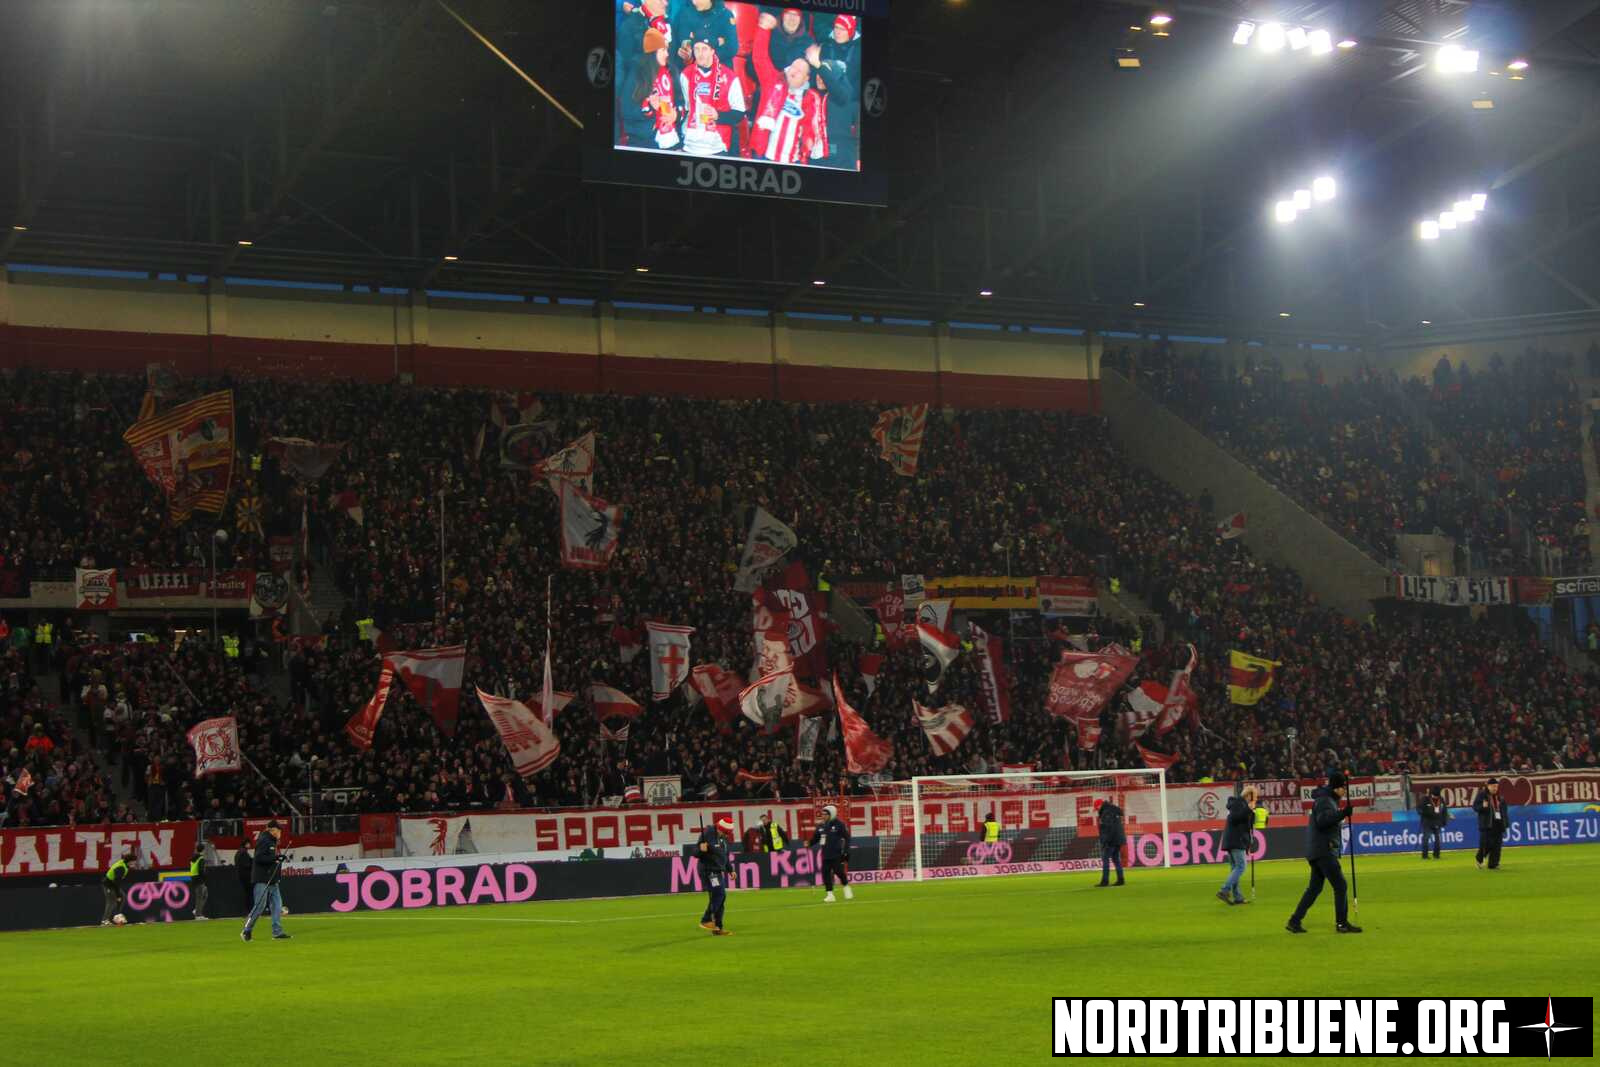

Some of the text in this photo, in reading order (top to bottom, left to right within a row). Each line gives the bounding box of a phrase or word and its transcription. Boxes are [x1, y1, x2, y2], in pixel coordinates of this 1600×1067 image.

[676, 160, 803, 195] JOBRAD
[1526, 819, 1570, 842] LIEBE
[1575, 817, 1599, 840] ZU
[0, 829, 175, 873] ALTEN
[671, 854, 761, 893] Min
[847, 870, 904, 883] JOBRAD
[928, 866, 978, 879] JOBRAD
[995, 862, 1042, 875] JOBRAD
[331, 862, 538, 913] JOBRAD
